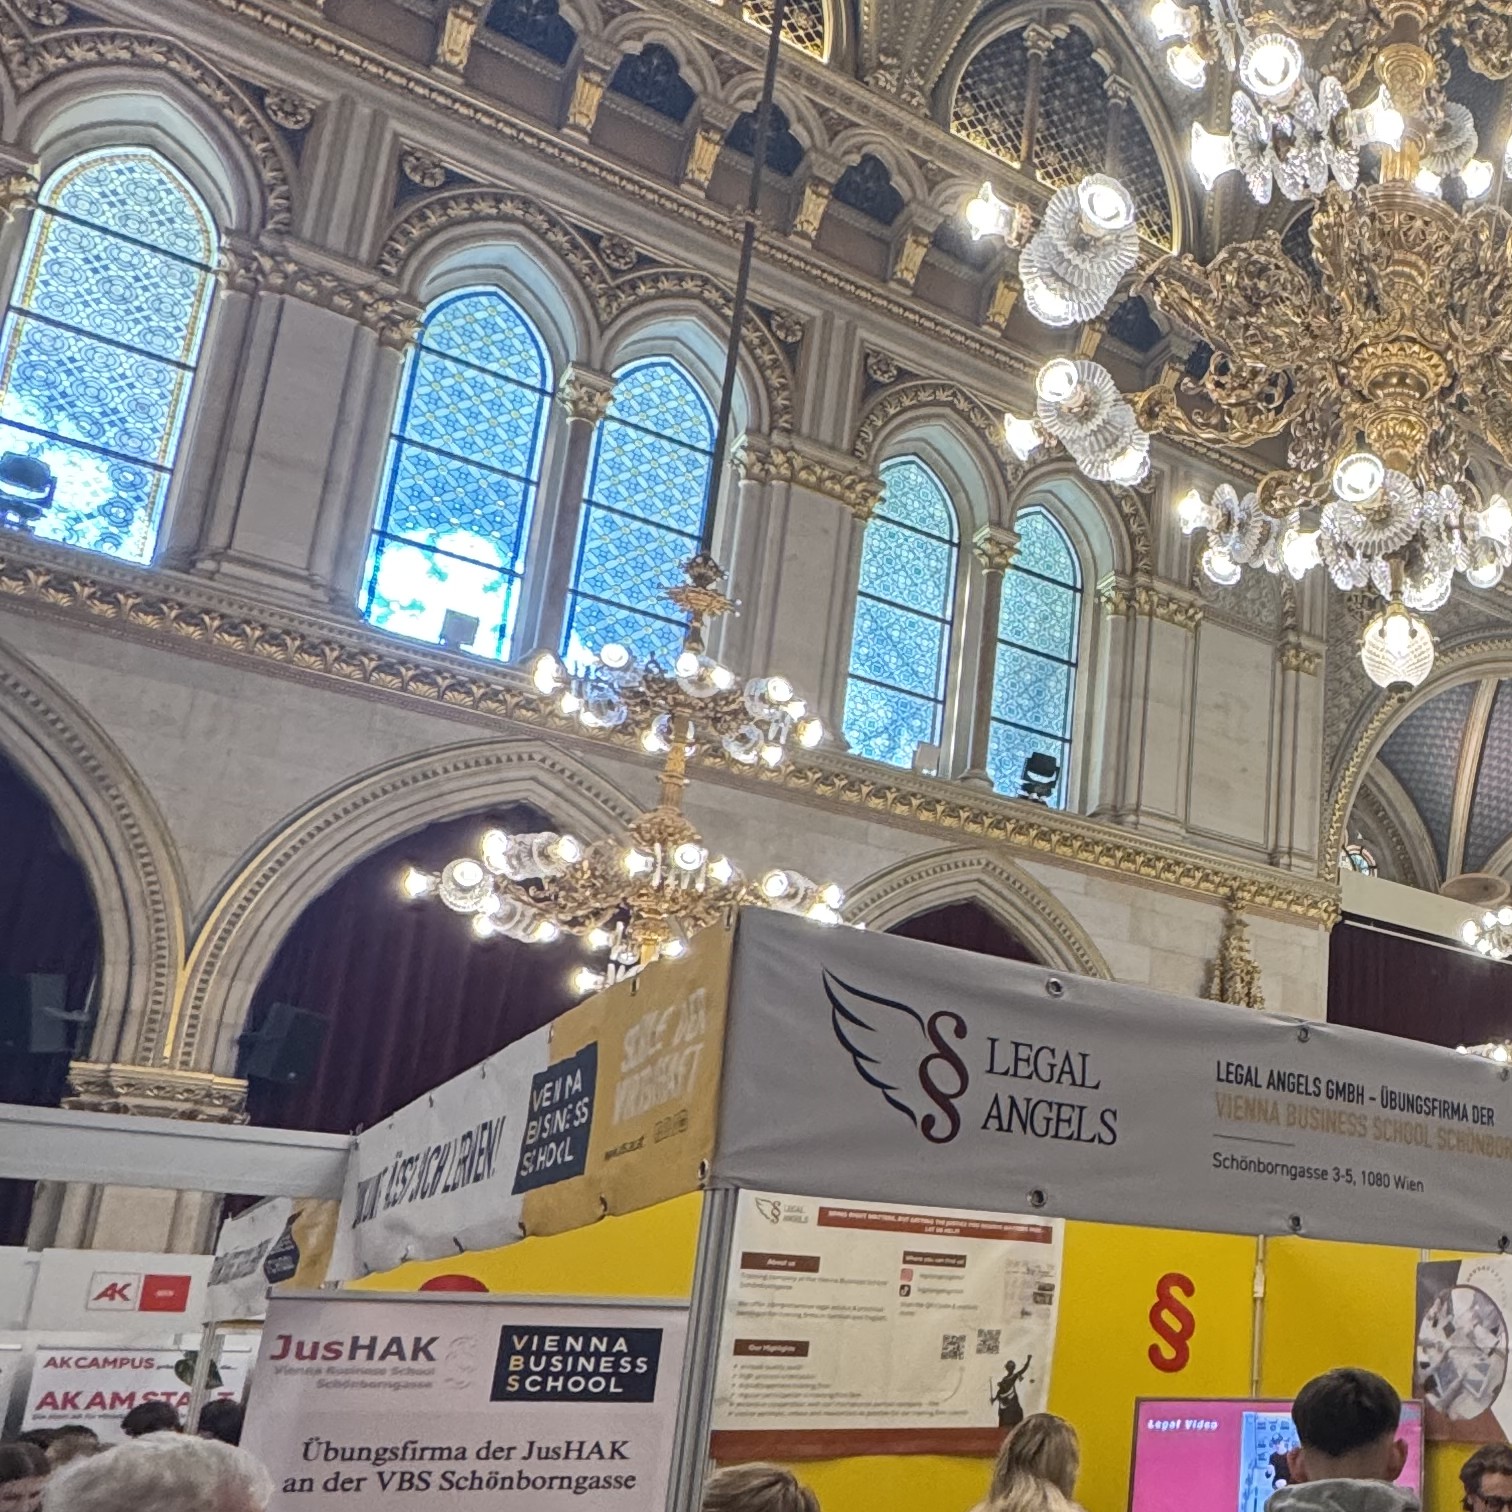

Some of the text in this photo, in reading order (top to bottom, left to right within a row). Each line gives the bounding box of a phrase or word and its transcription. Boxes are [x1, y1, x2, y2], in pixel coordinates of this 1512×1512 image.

[985, 1037, 1101, 1089] LEGAL
[1217, 1060, 1262, 1088] LEGAL
[1266, 1069, 1322, 1097] ANGELS
[1326, 1079, 1365, 1105] GMBH
[1380, 1085, 1469, 1122] ÜBUNGSFIRMA
[1472, 1105, 1495, 1126] DER
[981, 1093, 1117, 1145] ANGELS
[1216, 1092, 1280, 1126] VIENNA
[1286, 1103, 1367, 1137] BUSINESS
[1373, 1114, 1432, 1148] SCHOOL
[1213, 1152, 1425, 1192] Schönborngasse 3-5, 1080 Wien
[92, 1283, 132, 1301] AK
[270, 1335, 440, 1361] JusHAK
[513, 1335, 628, 1352] VIENNA
[43, 1356, 73, 1369] AK
[74, 1356, 155, 1369] CAMPUS
[509, 1355, 648, 1373] BUSINESS
[506, 1375, 623, 1392] SCHOOL
[35, 1391, 83, 1411] AK
[84, 1391, 136, 1411] AM
[303, 1437, 631, 1466] Übungsfirma der JusHAK
[283, 1470, 637, 1495] an der VBS Schönborngasse
